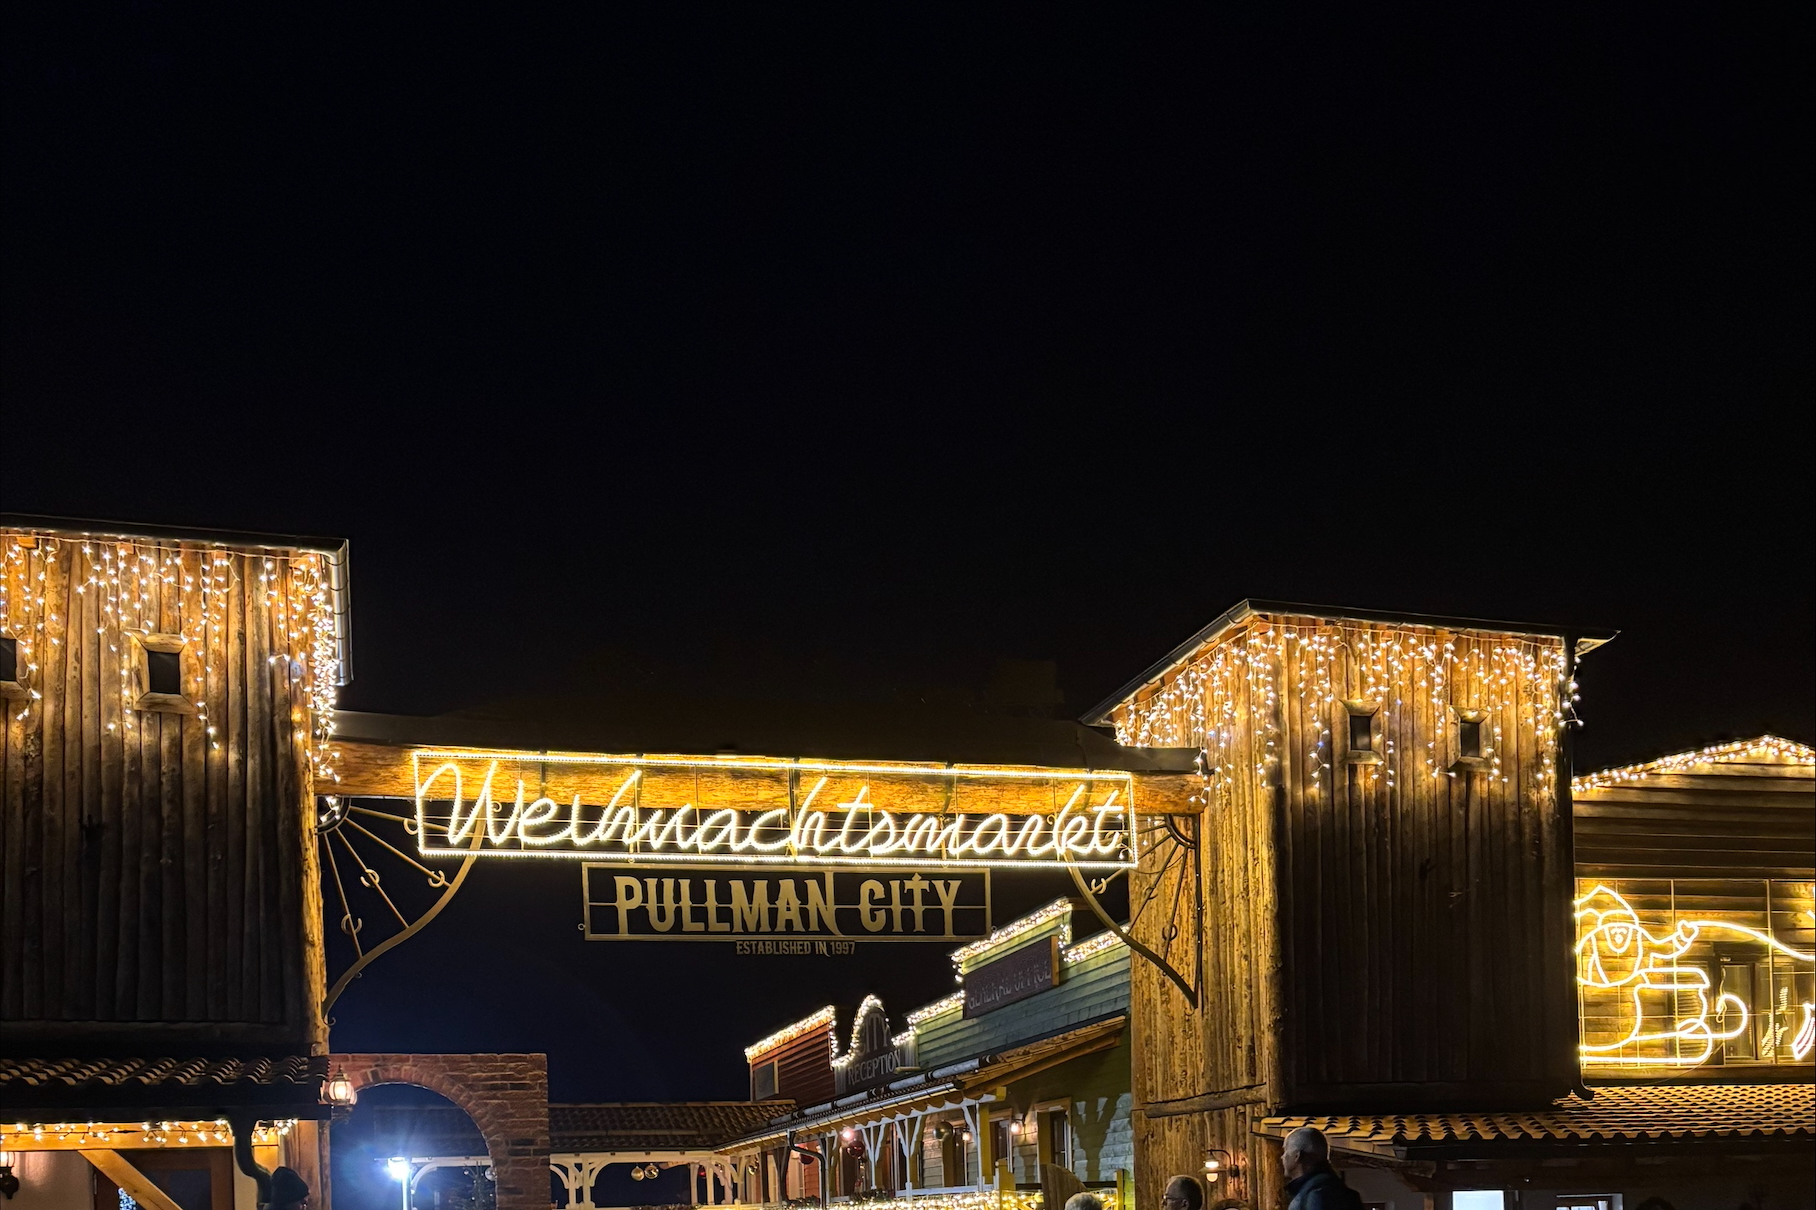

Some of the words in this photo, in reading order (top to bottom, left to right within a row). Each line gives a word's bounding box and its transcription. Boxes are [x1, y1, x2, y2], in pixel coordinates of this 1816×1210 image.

[419, 759, 1126, 856] Weihnachtsmarkt
[613, 871, 845, 937] PULLMAN
[858, 872, 963, 937] CITY
[735, 941, 812, 956] ESTABLISHED
[815, 941, 831, 957] IN
[831, 941, 856, 956] 1997
[847, 1049, 901, 1086] RECEPTION
